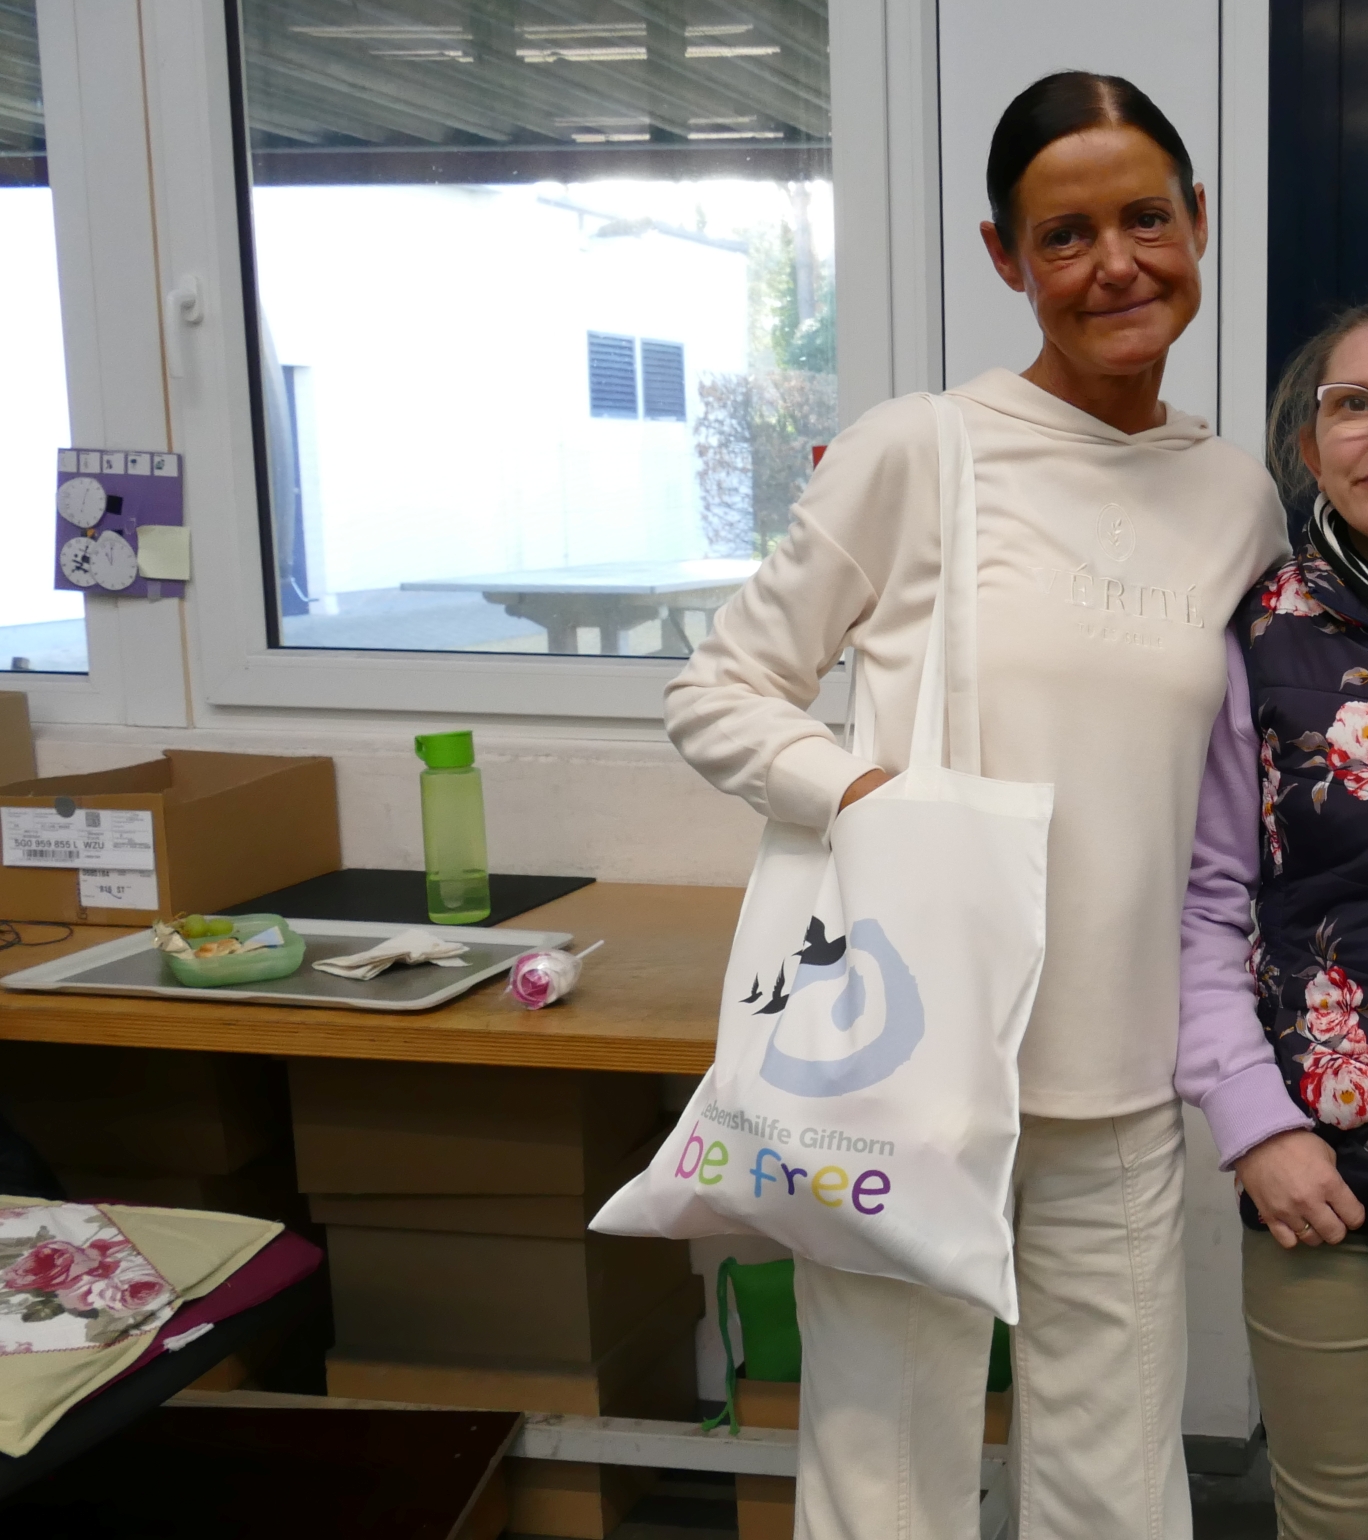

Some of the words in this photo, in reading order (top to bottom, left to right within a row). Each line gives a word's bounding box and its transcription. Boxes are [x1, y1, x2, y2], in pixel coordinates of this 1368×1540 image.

[1026, 563, 1205, 629] VÉRITÉ
[35, 839, 52, 849] 959
[83, 841, 105, 850] WZU
[798, 1126, 896, 1157] Gifhorn
[674, 1119, 729, 1186] be
[749, 1147, 892, 1216] free
